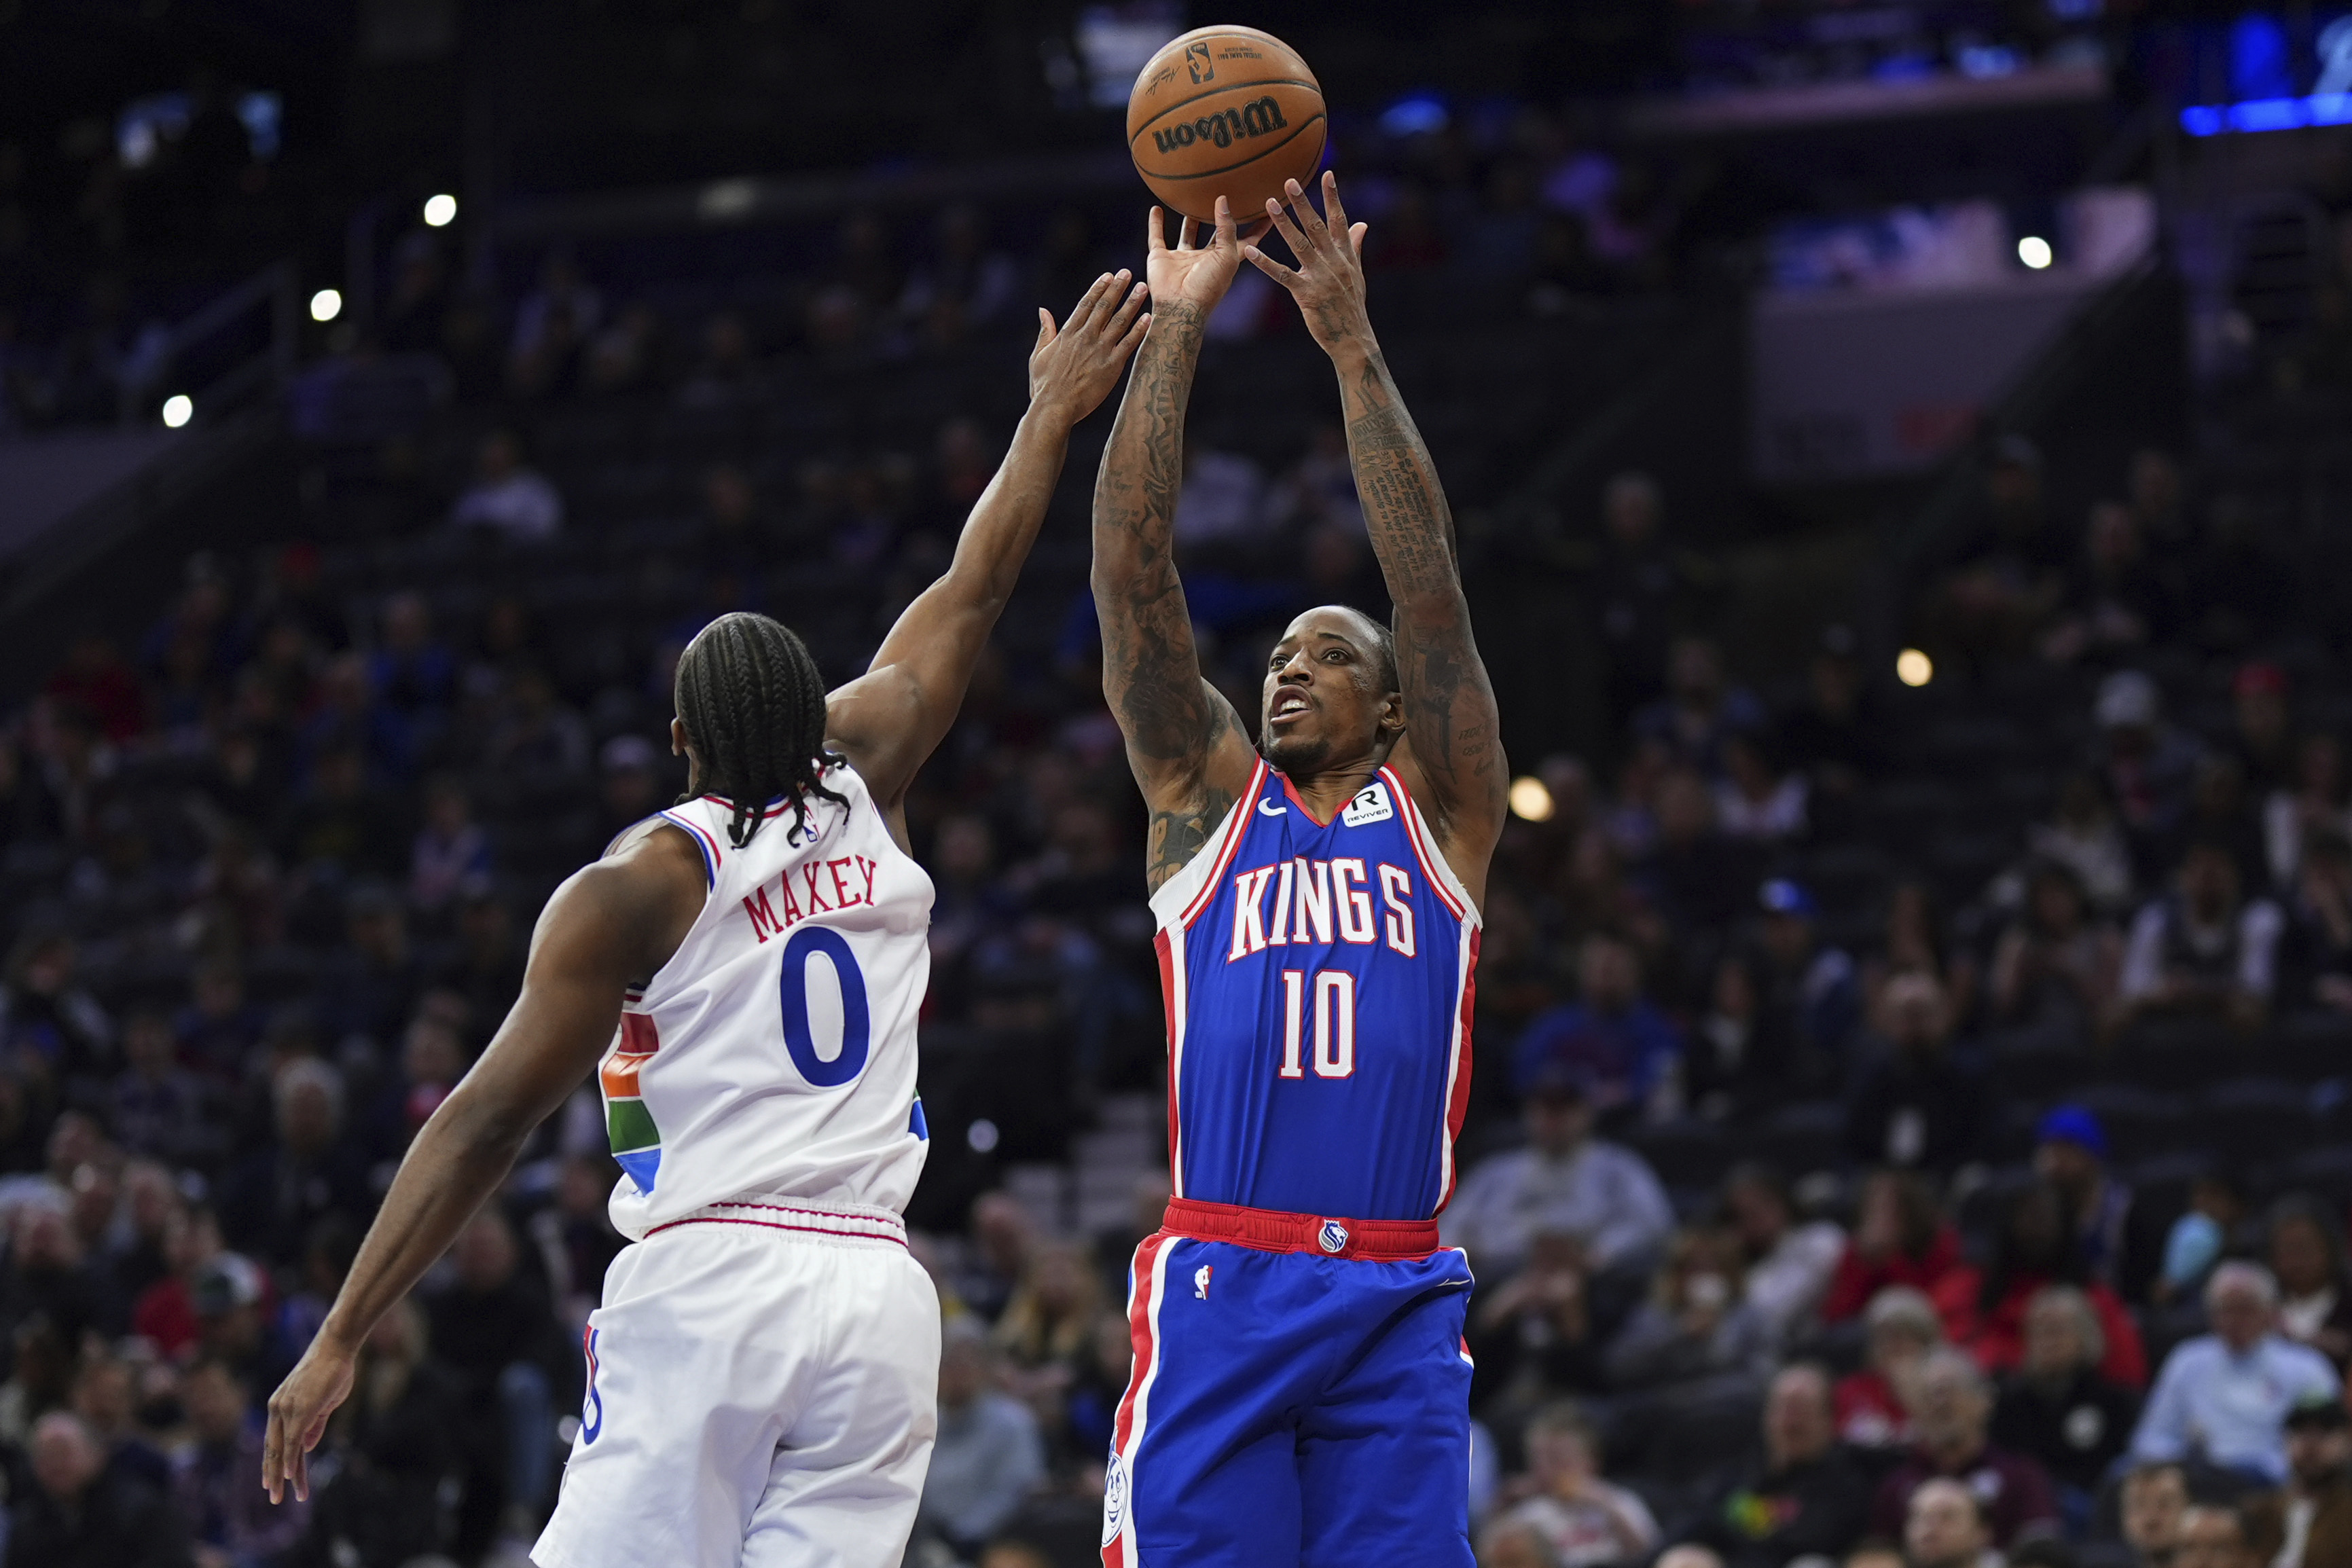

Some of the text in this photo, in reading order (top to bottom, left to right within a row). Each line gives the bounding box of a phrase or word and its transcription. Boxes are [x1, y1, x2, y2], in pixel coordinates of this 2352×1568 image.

[1152, 95, 1288, 154] Wilson
[1347, 808, 1389, 823] REVIVER
[742, 854, 876, 943] MAXEY
[1227, 854, 1417, 964] KINGS
[780, 926, 870, 1087] 0
[1279, 969, 1356, 1078] 10
